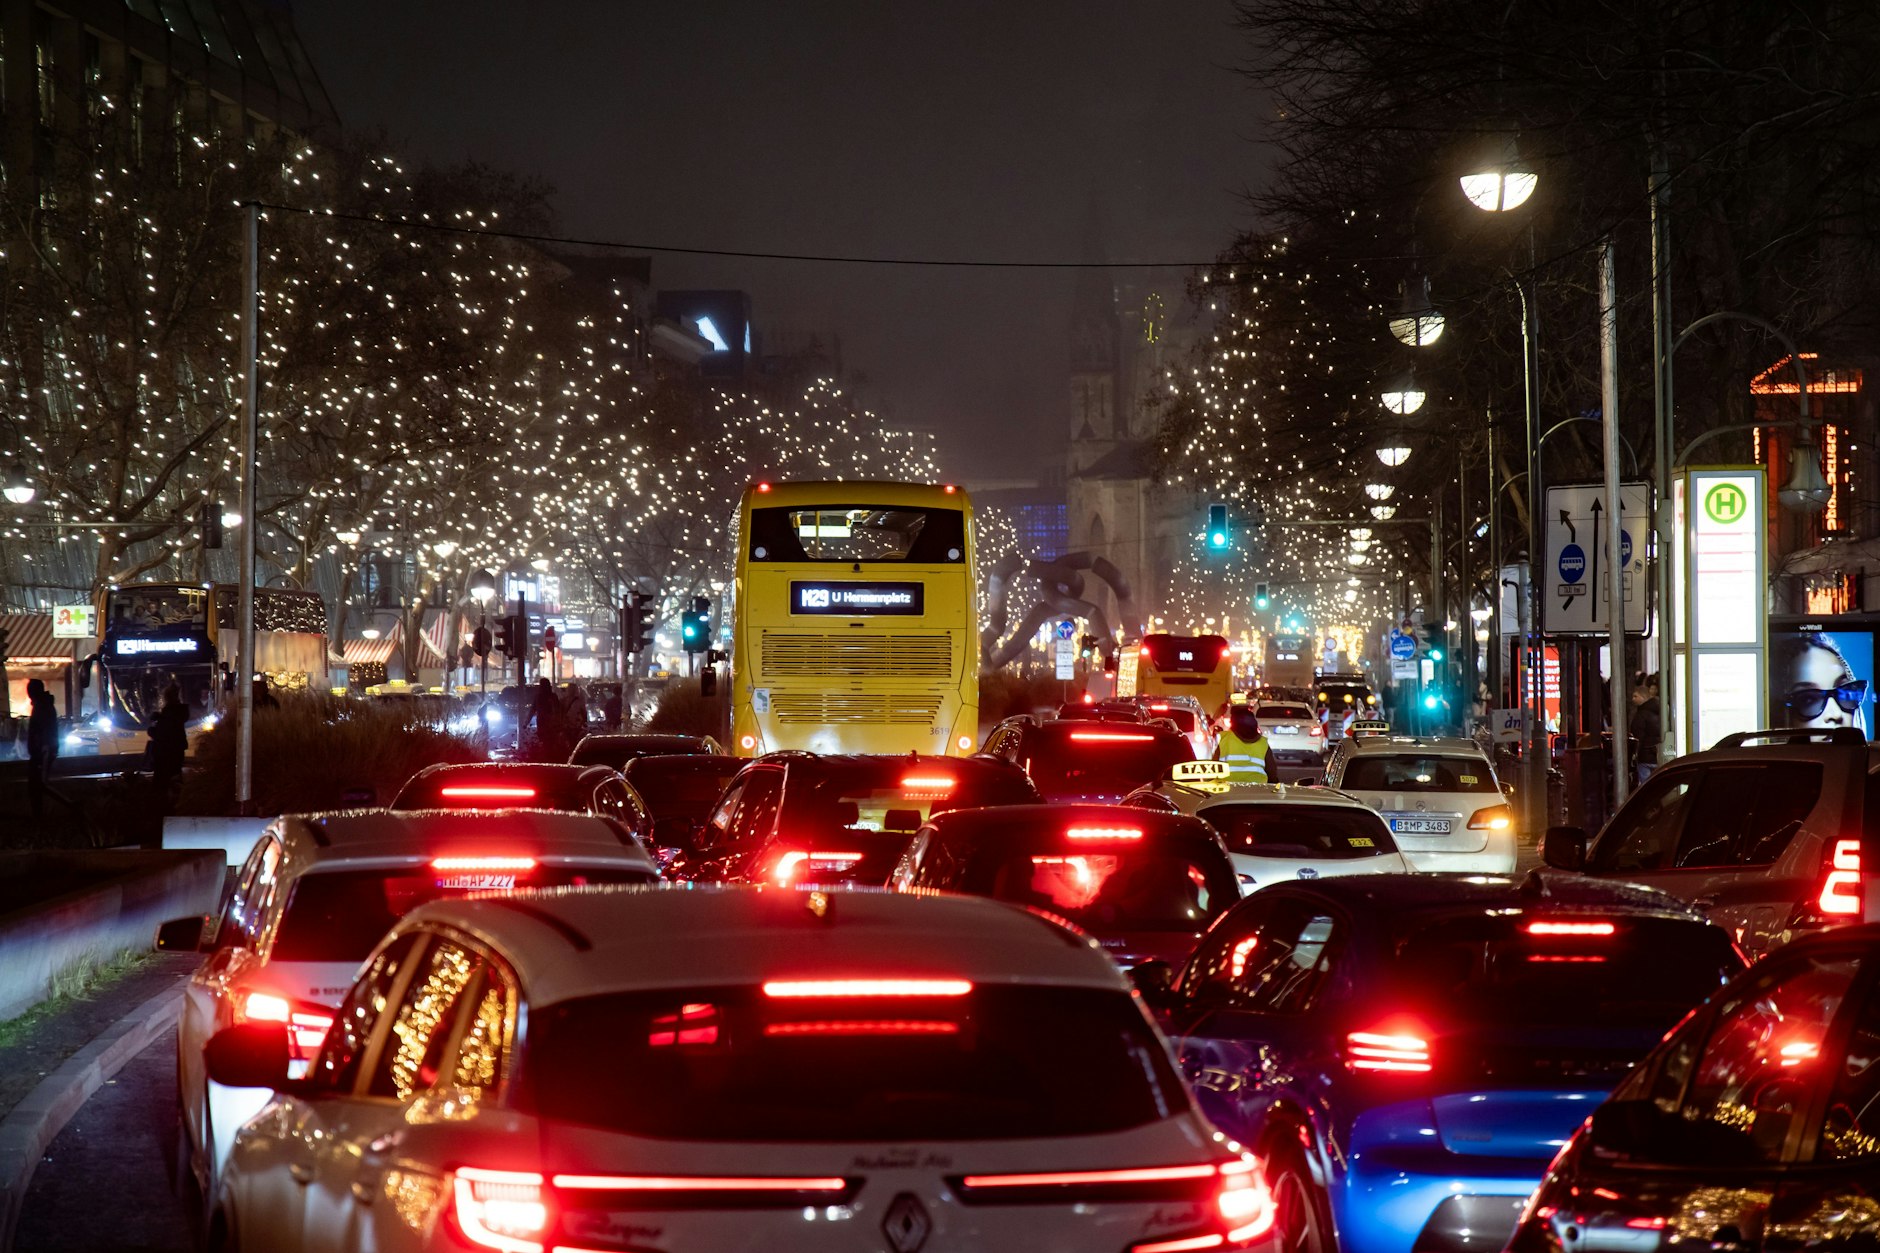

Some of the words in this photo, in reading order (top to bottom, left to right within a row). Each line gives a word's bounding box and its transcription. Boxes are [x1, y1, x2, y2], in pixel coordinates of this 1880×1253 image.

[1716, 492, 1736, 515] H
[801, 588, 829, 607] M29
[831, 591, 841, 602] U
[843, 591, 911, 605] Hermannplatz
[930, 727, 950, 735] 3619
[1185, 764, 1220, 774] TAXI
[1397, 821, 1403, 830] B
[1409, 821, 1422, 831] MP
[1424, 821, 1449, 831] 3483
[469, 875, 486, 887] AP
[489, 875, 513, 887] 227
